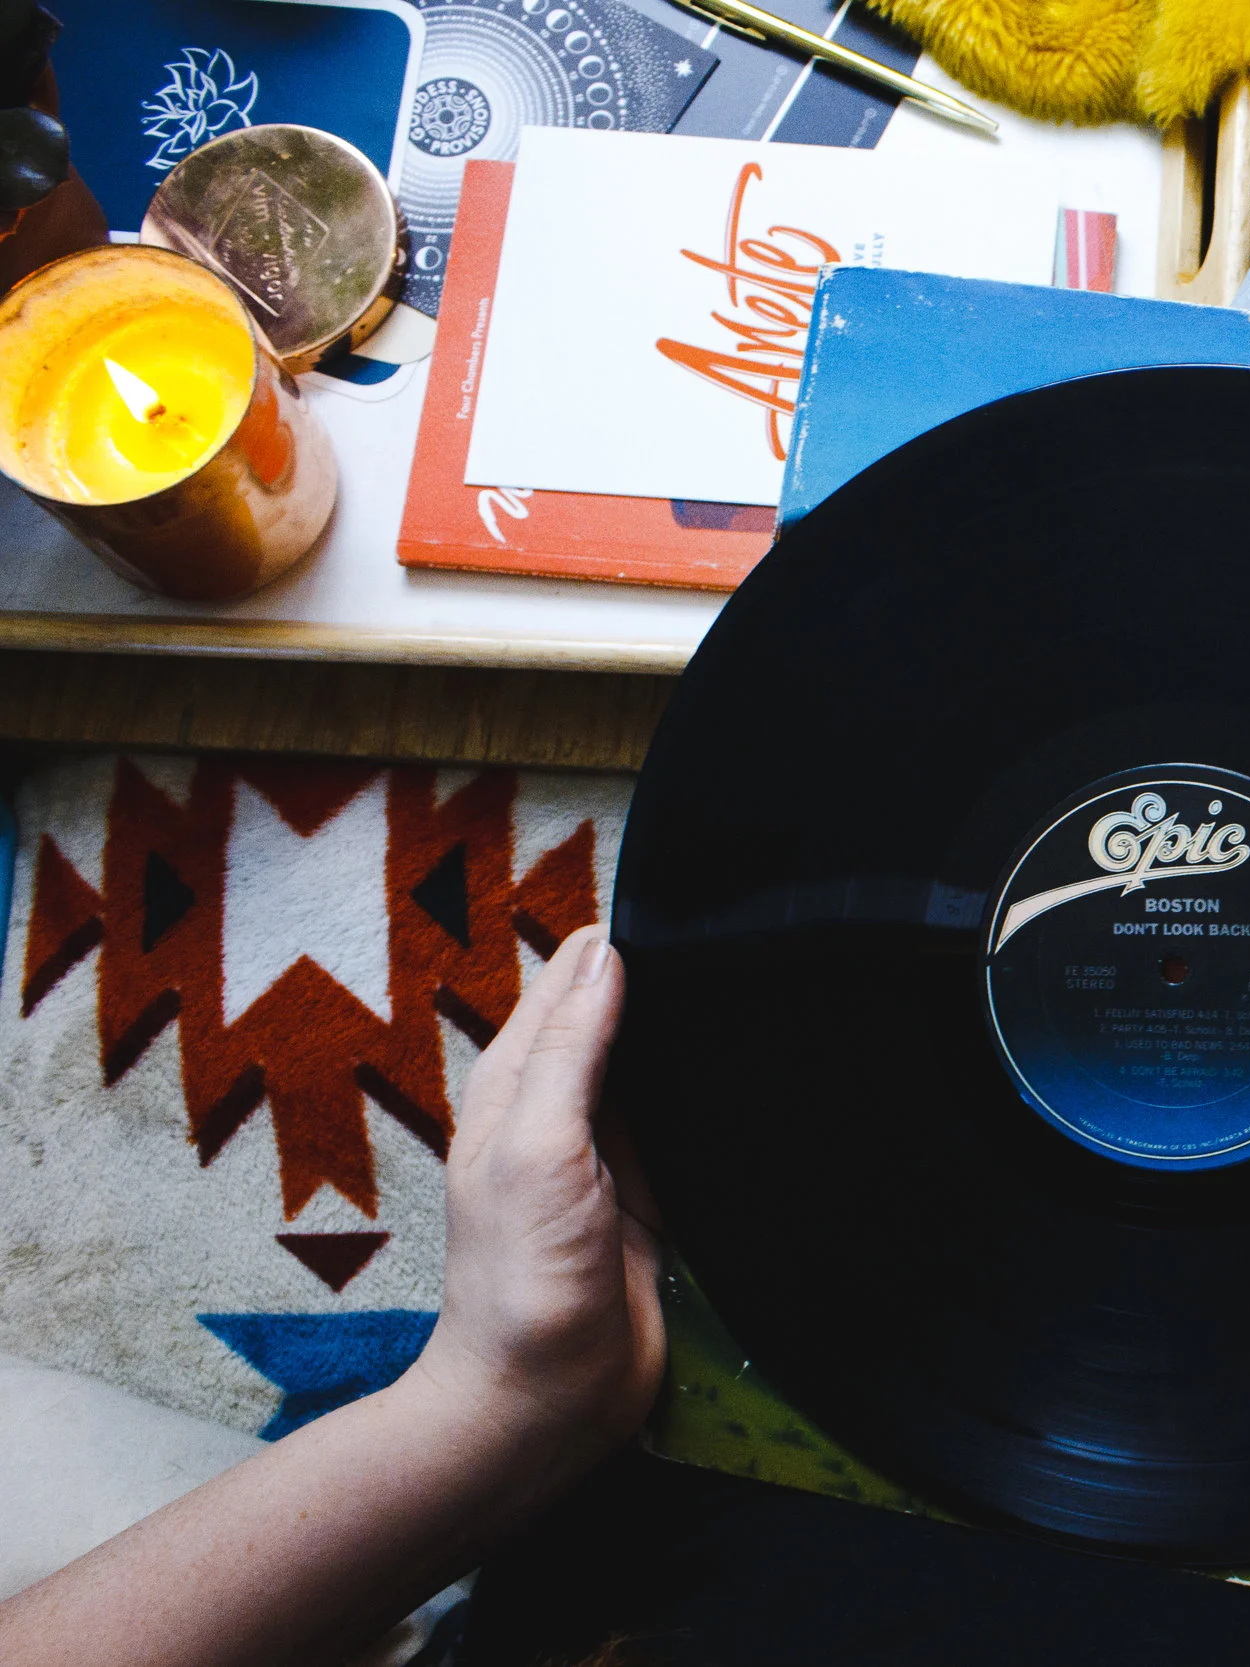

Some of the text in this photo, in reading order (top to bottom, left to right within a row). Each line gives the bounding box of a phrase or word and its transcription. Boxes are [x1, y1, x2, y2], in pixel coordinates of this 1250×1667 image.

[429, 88, 489, 155] PROVISIONS
[456, 297, 490, 419] Four Chambers Presents
[1144, 897, 1221, 914] BOSTON
[1112, 922, 1159, 936] DON'T
[1162, 923, 1204, 936] LOOK
[1065, 978, 1117, 991] STEREO
